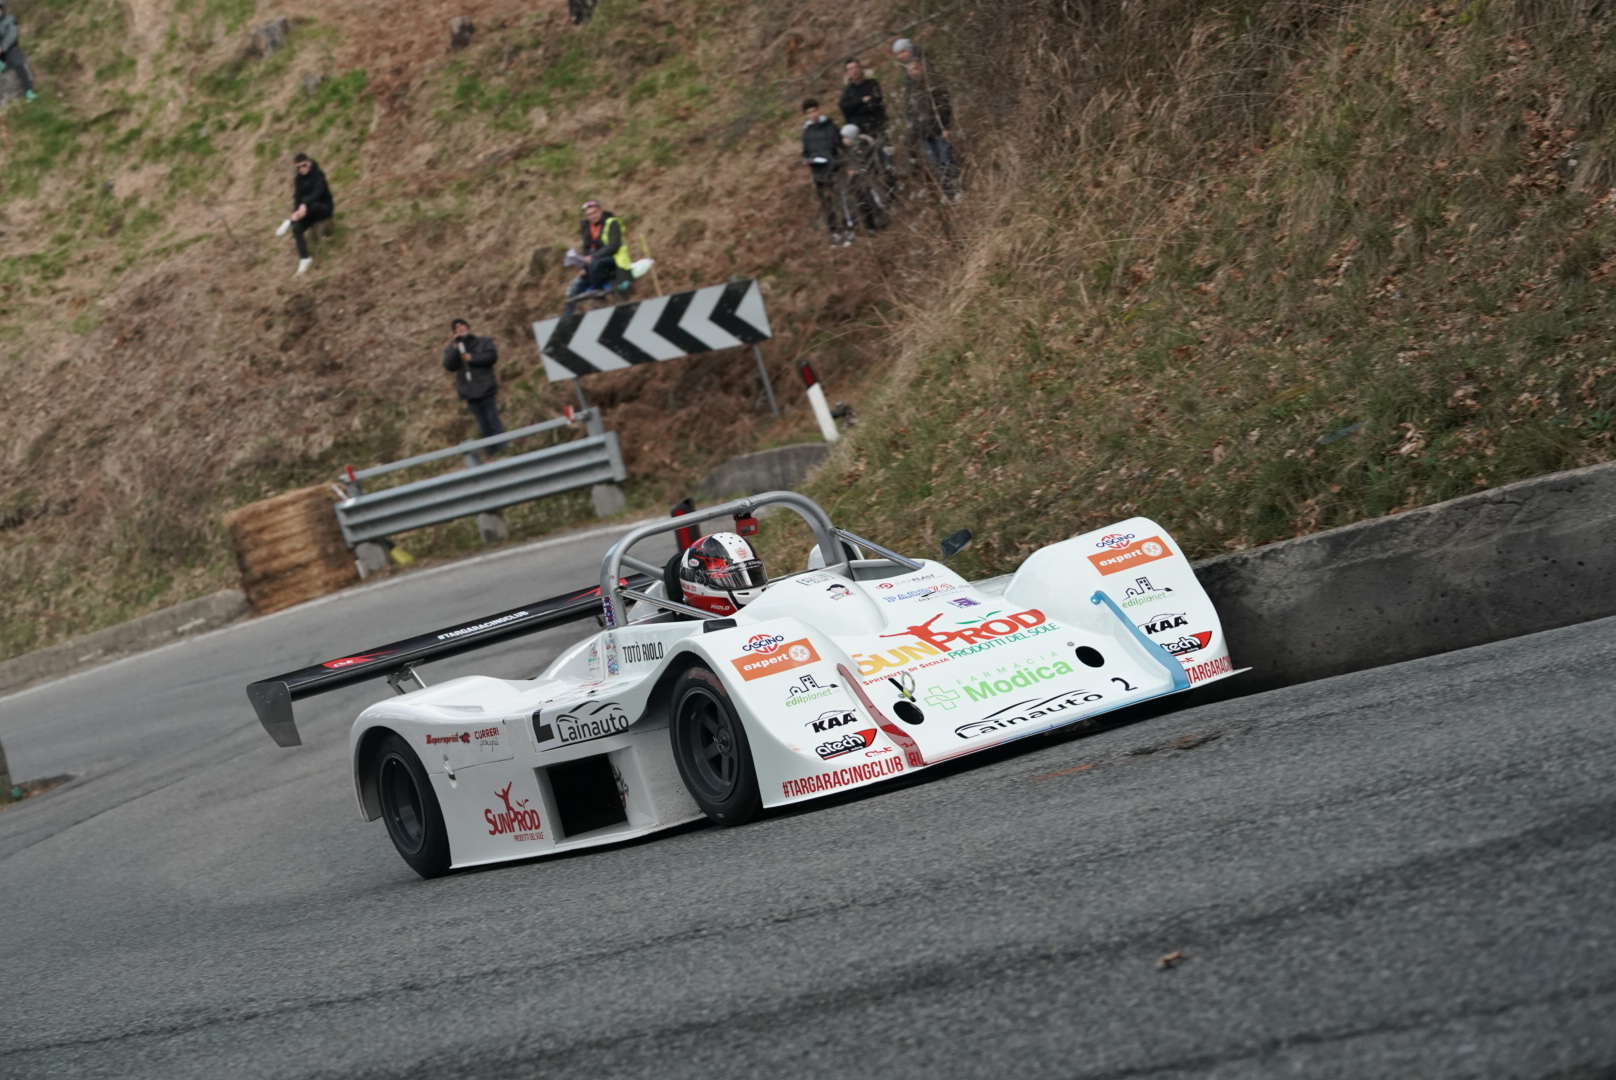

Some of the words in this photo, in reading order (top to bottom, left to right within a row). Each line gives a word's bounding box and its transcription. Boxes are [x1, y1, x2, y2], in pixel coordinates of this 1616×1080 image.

[1095, 533, 1136, 549] CASCINO
[1099, 548, 1143, 567] expert
[1121, 591, 1167, 609] edilplanet
[1144, 615, 1188, 635] KAA
[742, 634, 785, 652] CASCINO
[948, 638, 1006, 660] PRODOTTI
[1006, 632, 1028, 644] DEL
[1030, 622, 1060, 637] SOLE
[1160, 636, 1201, 654] tech
[622, 641, 642, 664] TOTÒ
[642, 641, 664, 662] RIOLO
[743, 653, 789, 672] expert
[919, 657, 950, 670] SICILIA
[956, 651, 1059, 686] FARMACIA
[962, 660, 1075, 703] Modica
[1110, 677, 1138, 692] 2
[785, 688, 832, 707] edilplanet
[556, 713, 629, 743] Lainauto
[812, 712, 858, 733] KAA
[474, 727, 500, 740] CURRERI
[815, 734, 866, 757] atech
[782, 755, 904, 798] #TARGARACINGCLUB
[484, 807, 541, 836] SUNPROD
